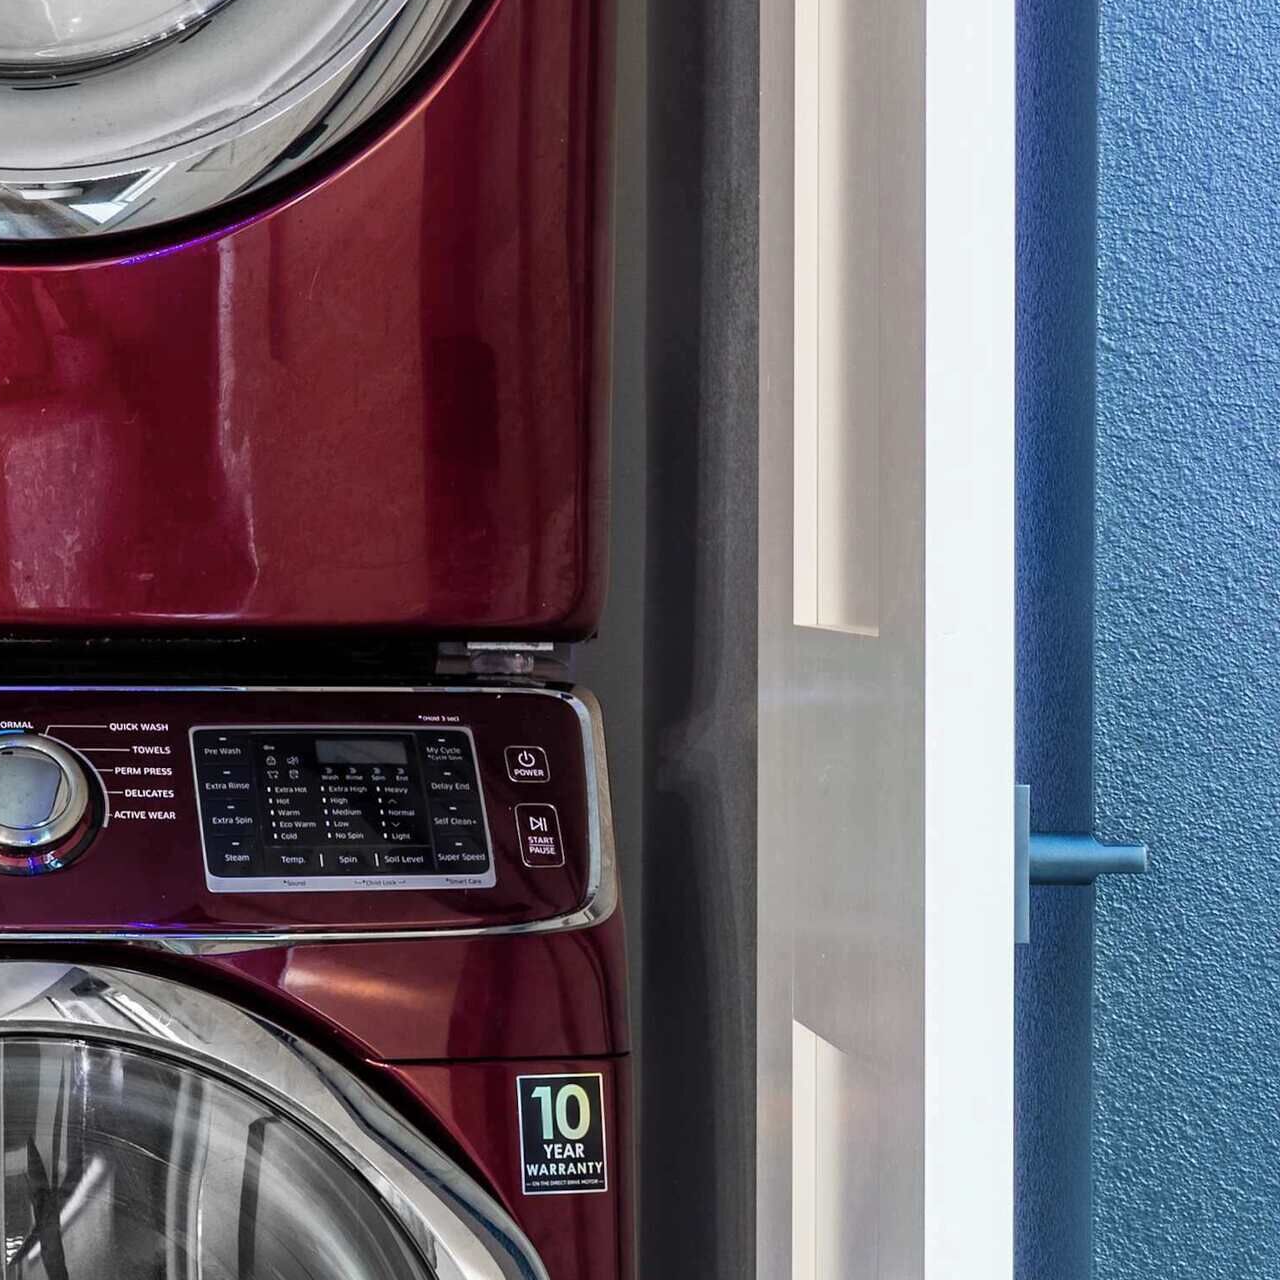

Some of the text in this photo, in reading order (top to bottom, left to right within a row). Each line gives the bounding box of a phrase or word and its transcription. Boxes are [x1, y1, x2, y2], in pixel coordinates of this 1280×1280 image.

[109, 723, 138, 731] QUICK
[132, 746, 171, 754] TOWELS
[115, 767, 141, 775] PERM
[514, 769, 545, 777] POWER
[125, 789, 174, 798] DELICATES
[114, 811, 146, 819] ACTIVE
[235, 817, 253, 825] Spin
[528, 836, 554, 844] START
[529, 846, 556, 854] PAUSE
[225, 854, 250, 862] Steam
[281, 856, 305, 864] Temp.
[437, 854, 485, 862] Super Speed
[531, 1084, 590, 1140] 10
[543, 1143, 585, 1159] YEAR
[526, 1162, 603, 1176] WARRANTY
